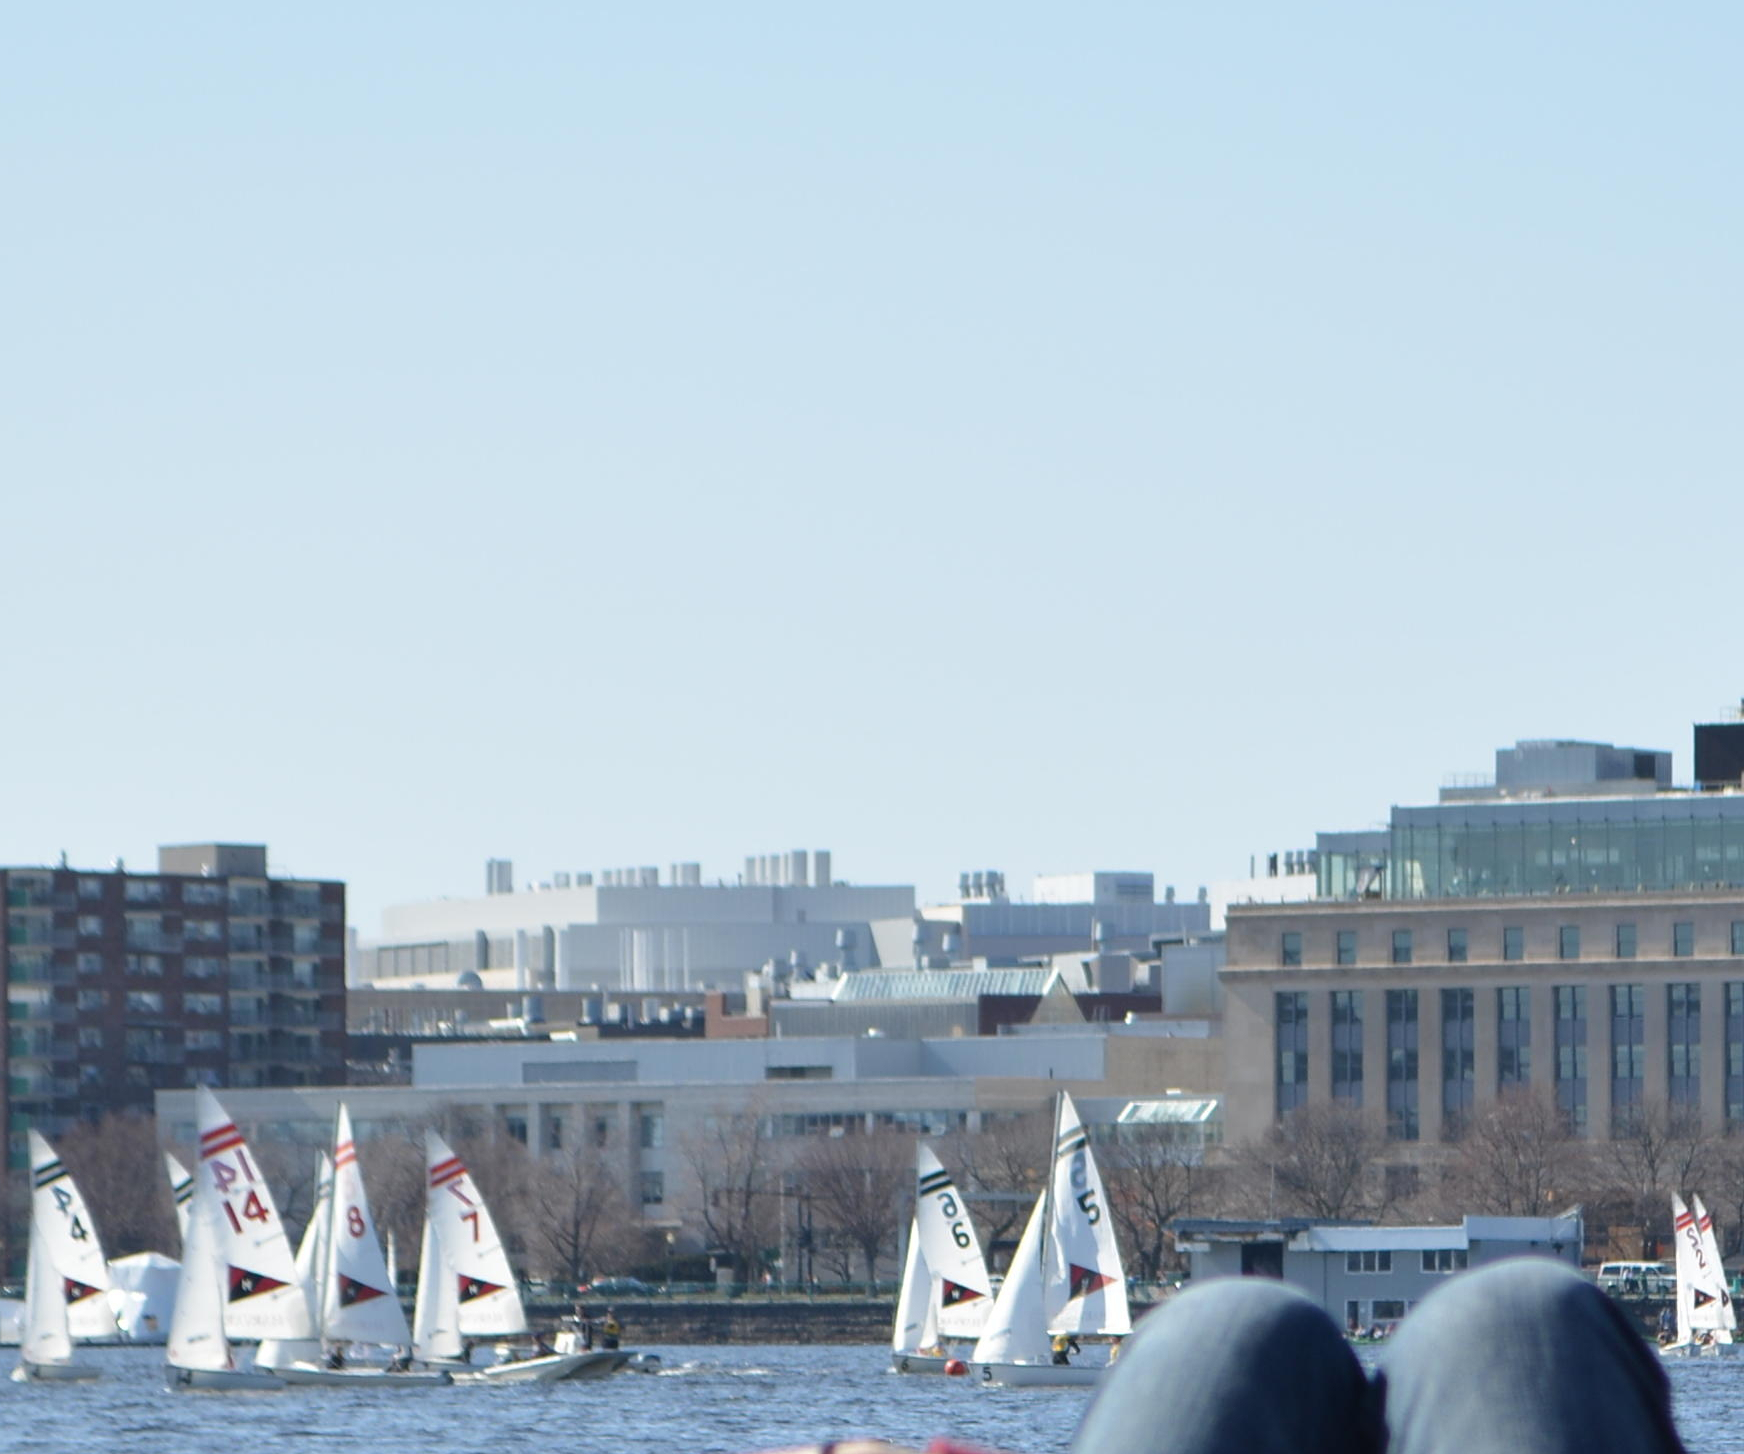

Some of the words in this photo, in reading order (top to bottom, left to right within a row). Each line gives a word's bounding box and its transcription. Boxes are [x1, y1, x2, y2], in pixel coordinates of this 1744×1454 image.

[222, 1190, 269, 1235] 14
[1077, 1189, 1100, 1225] 5
[70, 1214, 88, 1243] 4
[347, 1206, 366, 1239] 8
[460, 1211, 480, 1242] 7
[952, 1221, 970, 1249] 6
[1696, 1249, 1706, 1268] 2
[983, 1366, 993, 1382] 5
